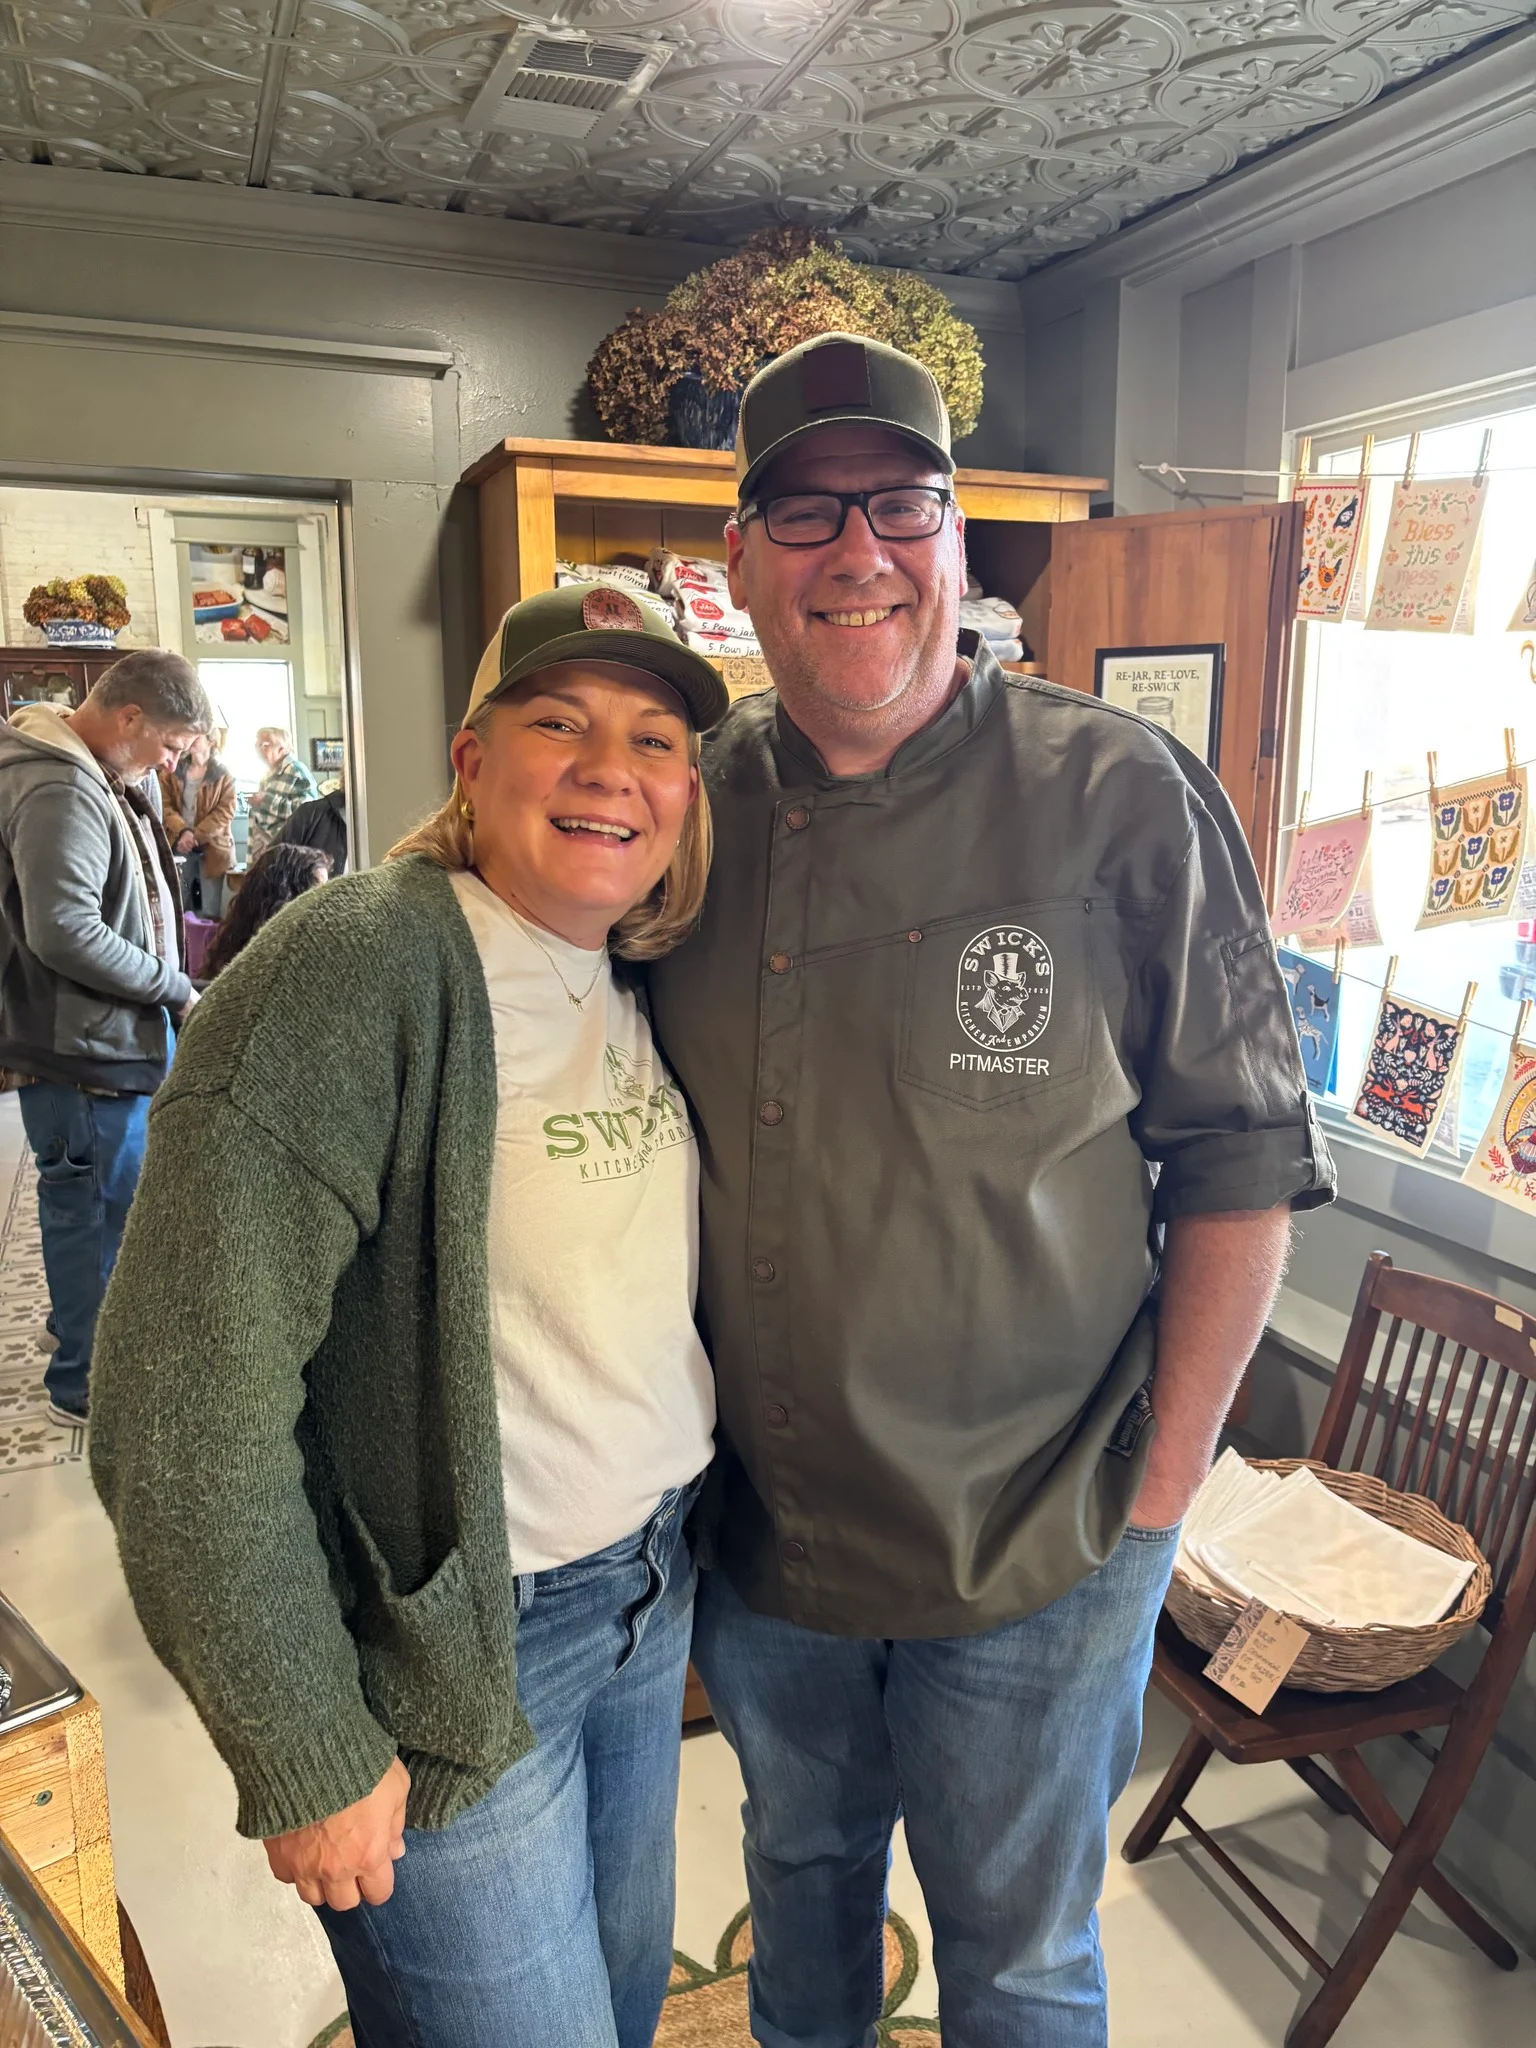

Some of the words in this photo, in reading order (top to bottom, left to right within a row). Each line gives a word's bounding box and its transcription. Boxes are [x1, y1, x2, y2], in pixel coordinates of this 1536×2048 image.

[1402, 520, 1456, 542] Bless
[1403, 545, 1441, 568] this
[713, 623, 736, 634] Pour
[719, 644, 742, 654] Pour
[1116, 671, 1152, 682] RE-JAR,
[1154, 670, 1200, 680] RE-LOVE,
[1132, 682, 1180, 692] RE-SWICK
[964, 931, 1050, 976] SWICK'S
[960, 1001, 986, 1042] KITCHEN
[1007, 1006, 1048, 1047] EMPORIUM
[950, 1053, 1050, 1076] PITMASTER
[580, 1155, 640, 1179] KITCH
